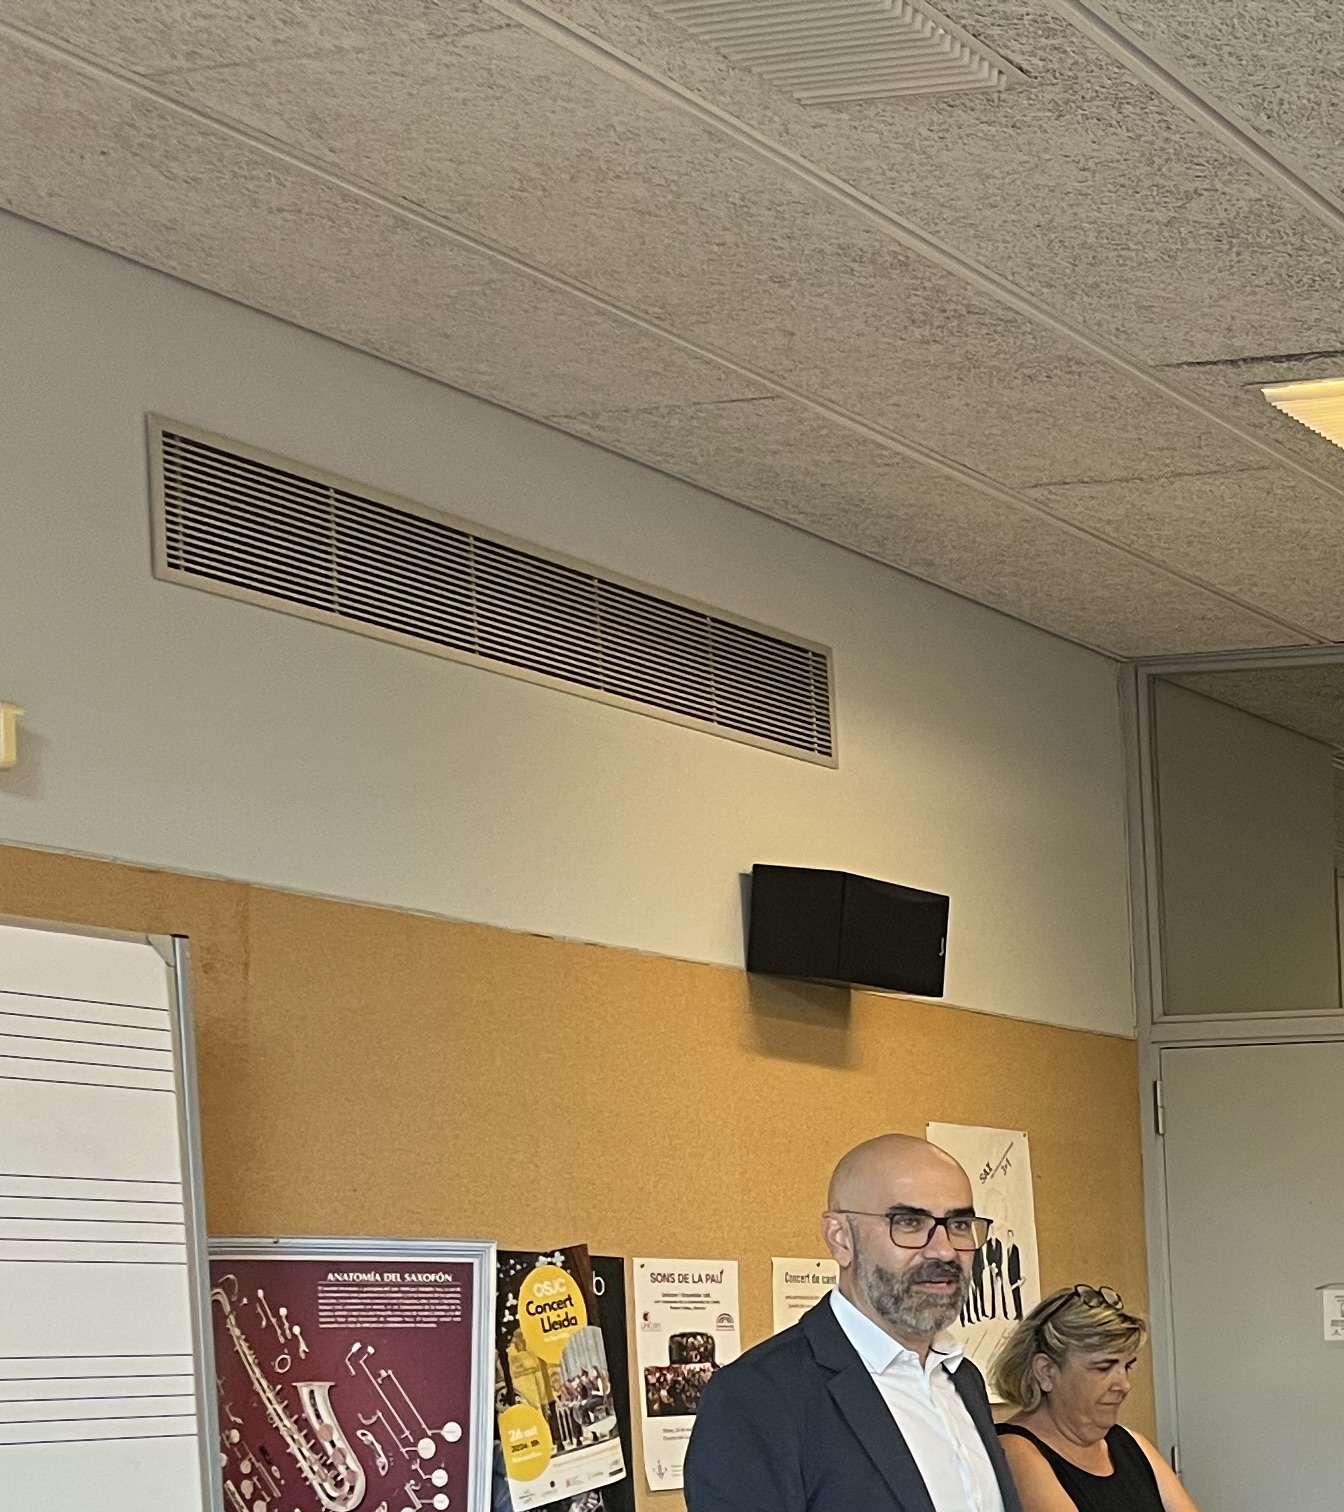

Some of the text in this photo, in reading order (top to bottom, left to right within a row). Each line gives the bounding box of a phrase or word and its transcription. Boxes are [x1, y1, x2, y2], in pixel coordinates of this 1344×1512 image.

[327, 1271, 453, 1282] ANATOMÍA DEL SAXOFÓN
[650, 1272, 675, 1283] SONS
[678, 1273, 690, 1283] DE
[692, 1273, 703, 1283] LA
[812, 1274, 820, 1284] de
[526, 1294, 574, 1316] Concert
[541, 1311, 578, 1333] Lleida
